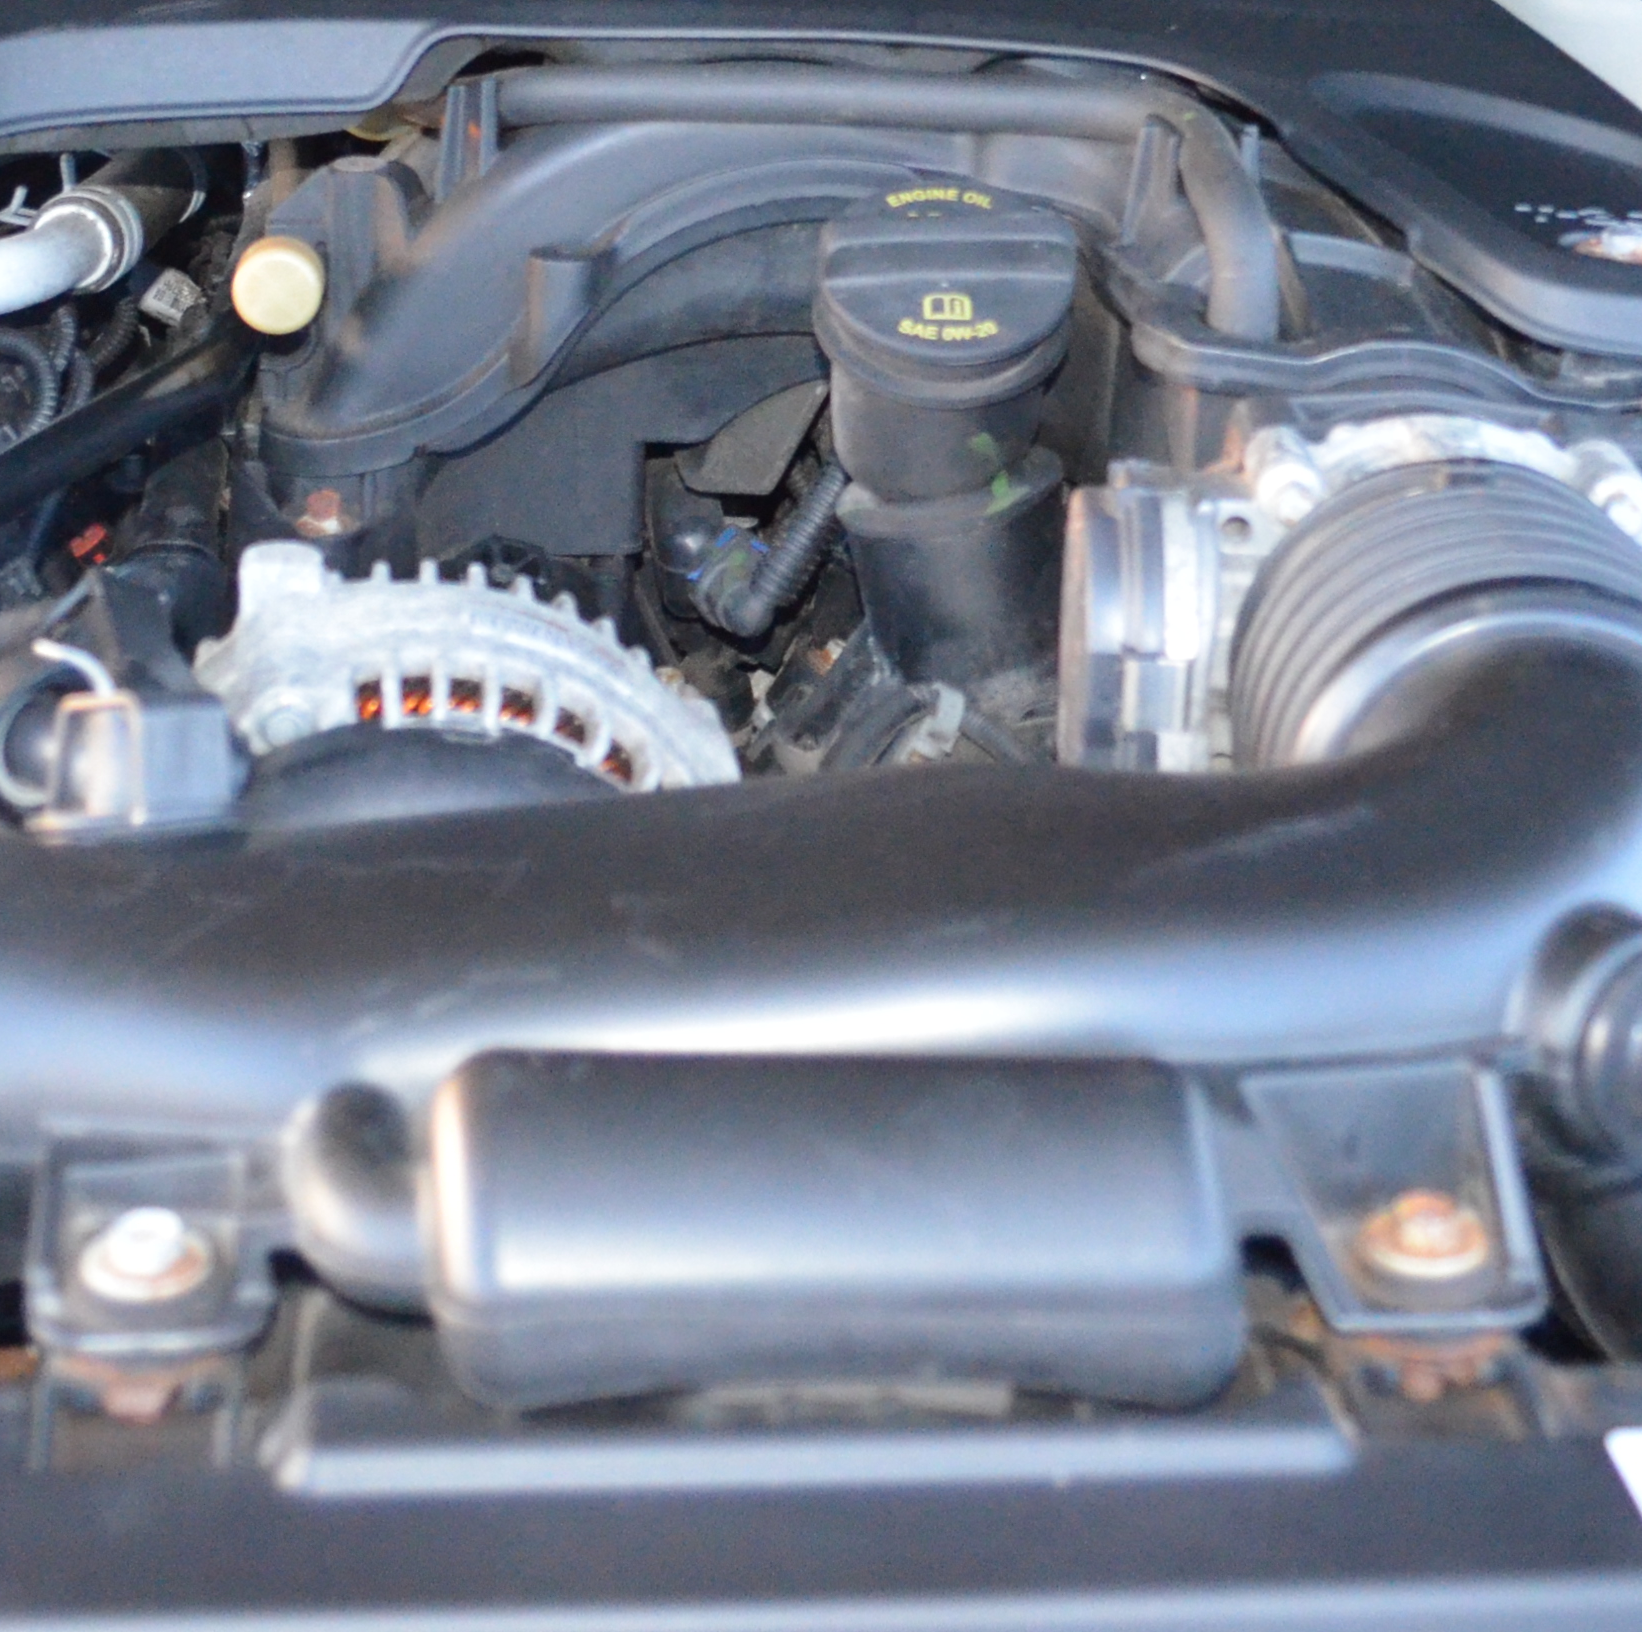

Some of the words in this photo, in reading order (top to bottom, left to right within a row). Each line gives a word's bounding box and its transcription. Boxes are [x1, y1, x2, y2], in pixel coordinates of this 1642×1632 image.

[886, 189, 958, 207] ENGINE
[963, 192, 991, 208] OIL
[899, 319, 938, 340] SAE
[942, 321, 997, 341] 0W-20
